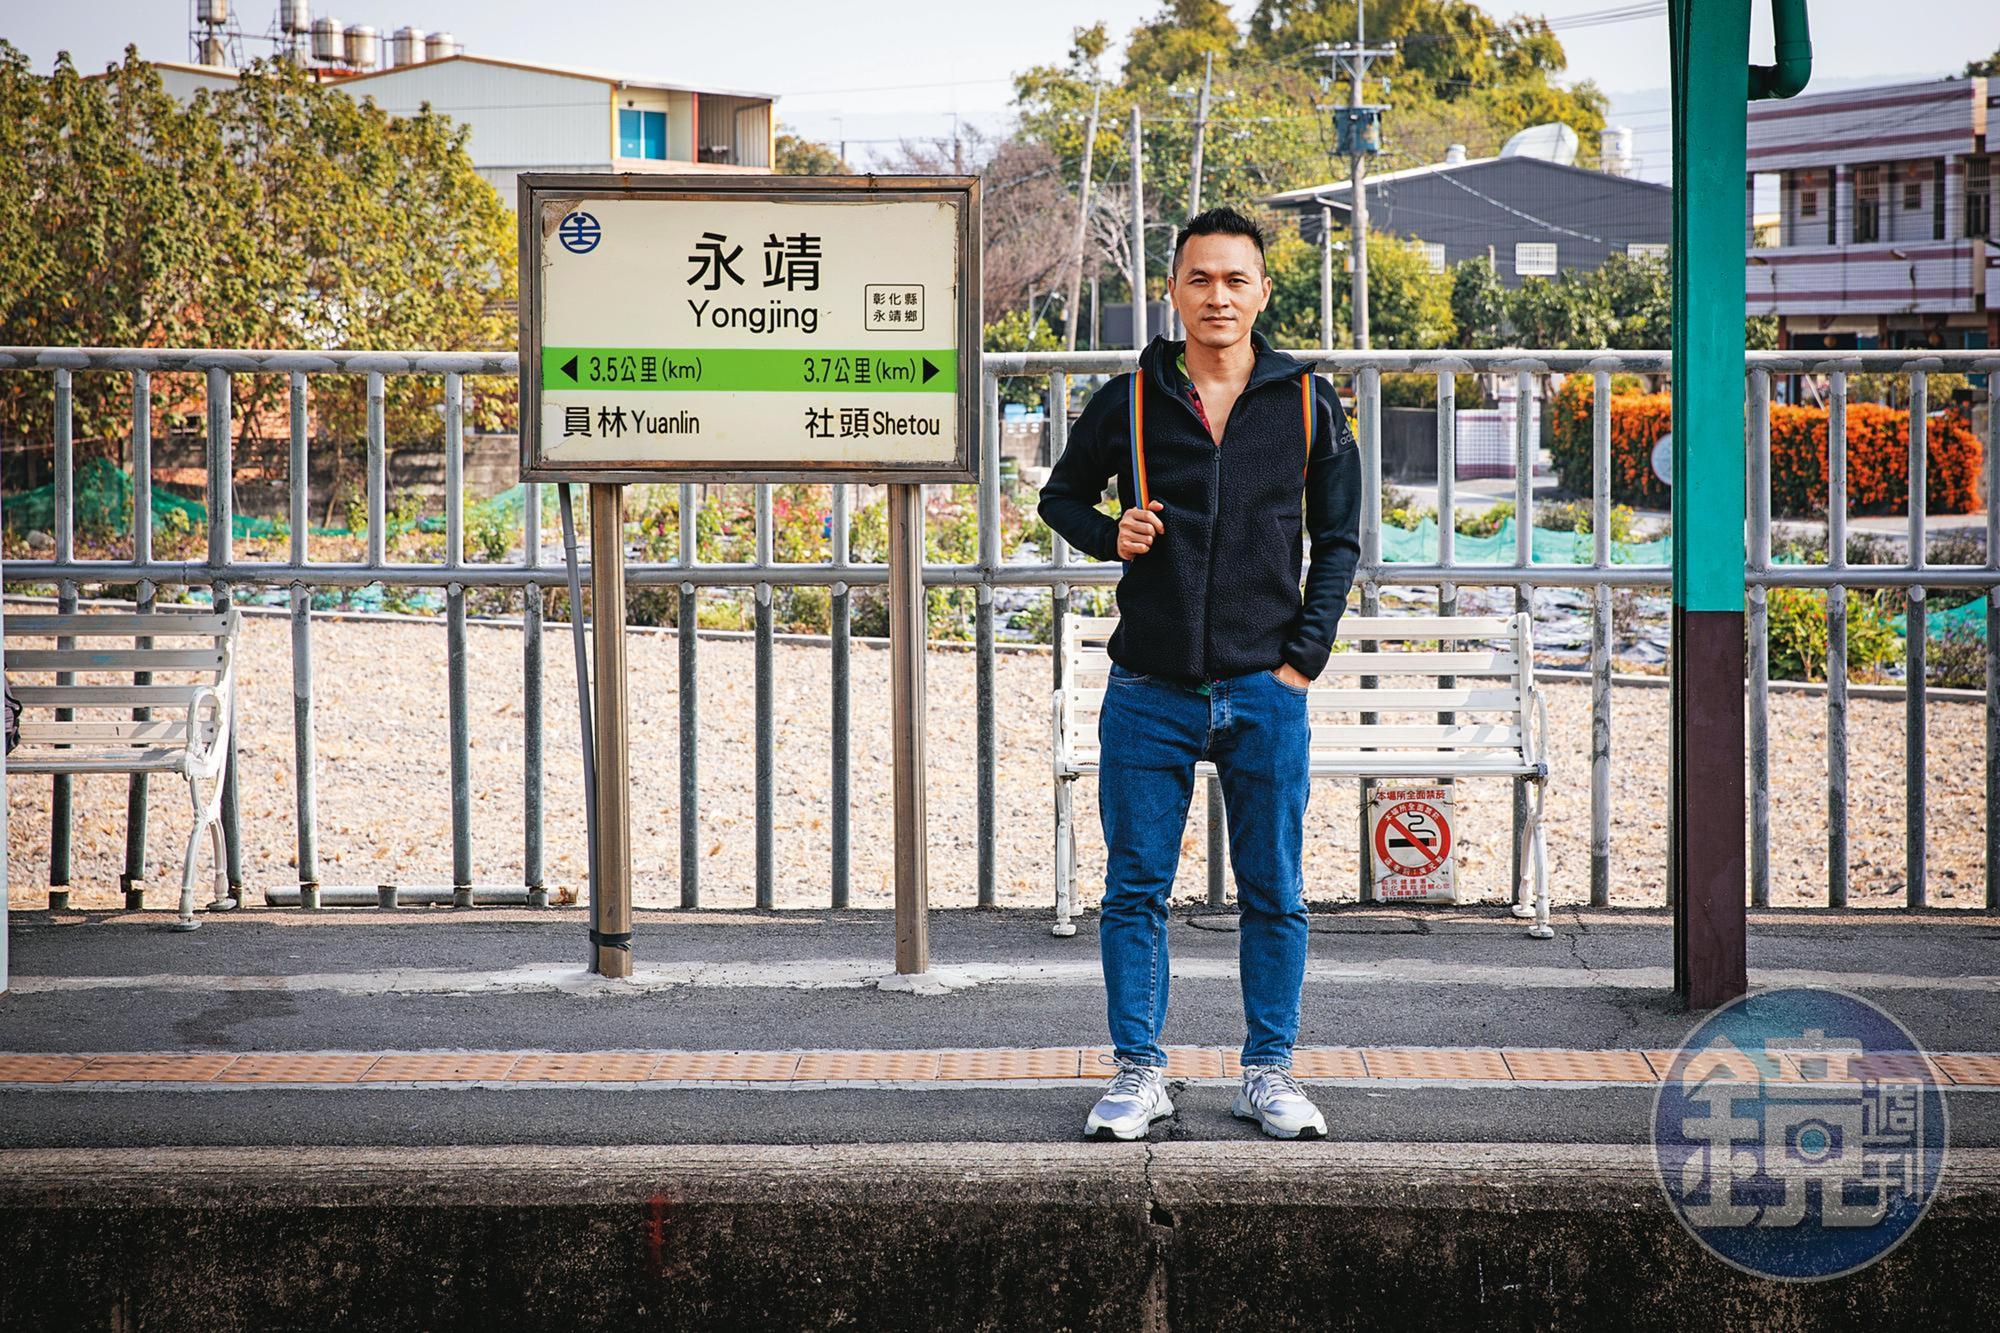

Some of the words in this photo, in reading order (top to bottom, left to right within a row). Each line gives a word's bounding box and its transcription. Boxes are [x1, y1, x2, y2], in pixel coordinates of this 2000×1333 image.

[686, 231, 822, 292] 永靖
[873, 292, 918, 306] 彰化縣
[687, 299, 818, 334] Yongjing
[873, 309, 918, 322] 永靖鄉
[563, 406, 628, 438] 員林
[630, 409, 700, 434] Yuanlin
[804, 406, 870, 438] 社頭
[872, 410, 940, 435] Shetou
